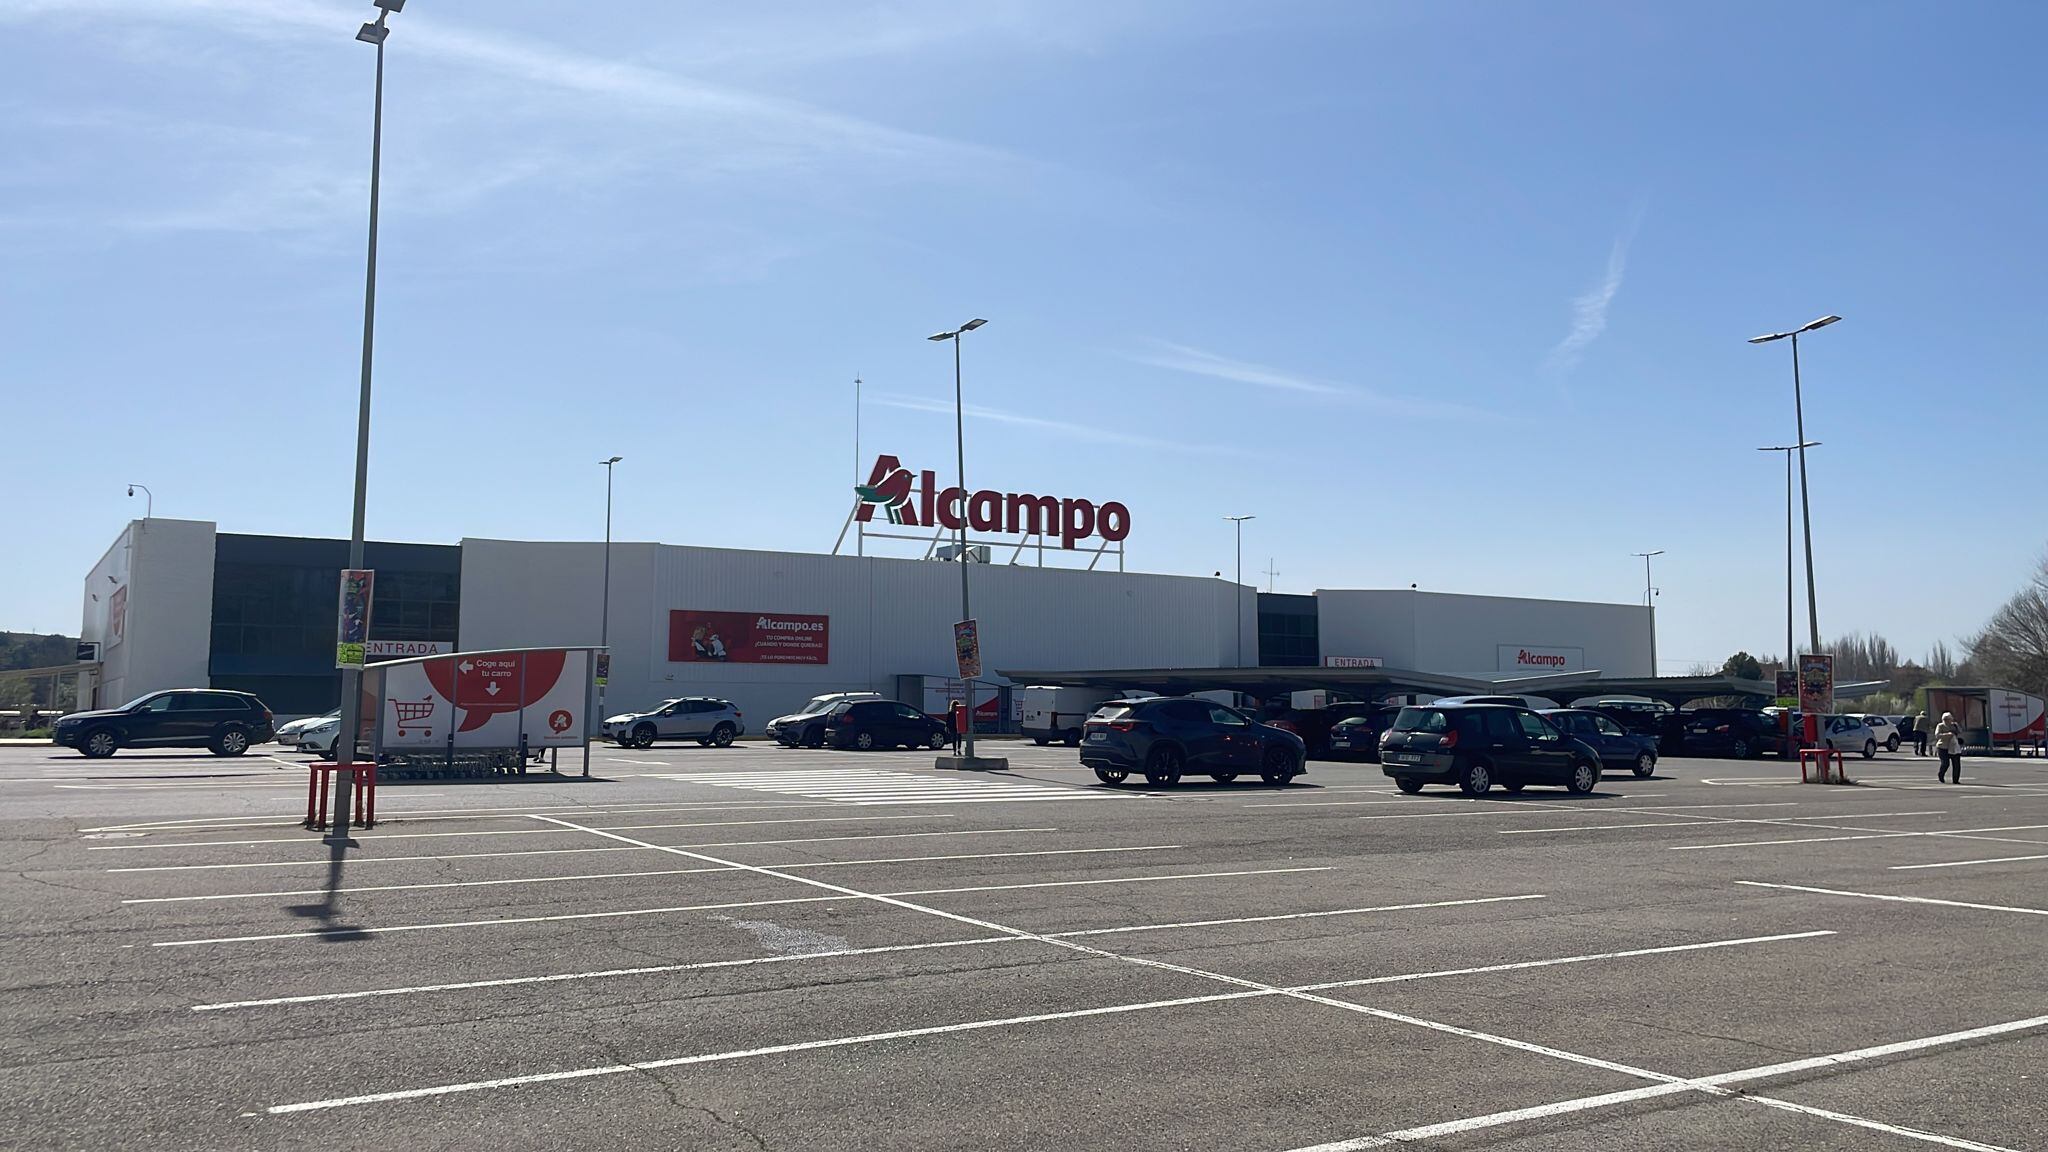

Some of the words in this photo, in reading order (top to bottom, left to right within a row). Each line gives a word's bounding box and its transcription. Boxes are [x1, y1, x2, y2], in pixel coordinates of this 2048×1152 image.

[853, 454, 1132, 549] Alcampo
[756, 616, 824, 632] Alcampo.es
[476, 659, 497, 668] Coge
[1334, 658, 1375, 668] ENTRADA
[1518, 649, 1566, 668] Alcampo
